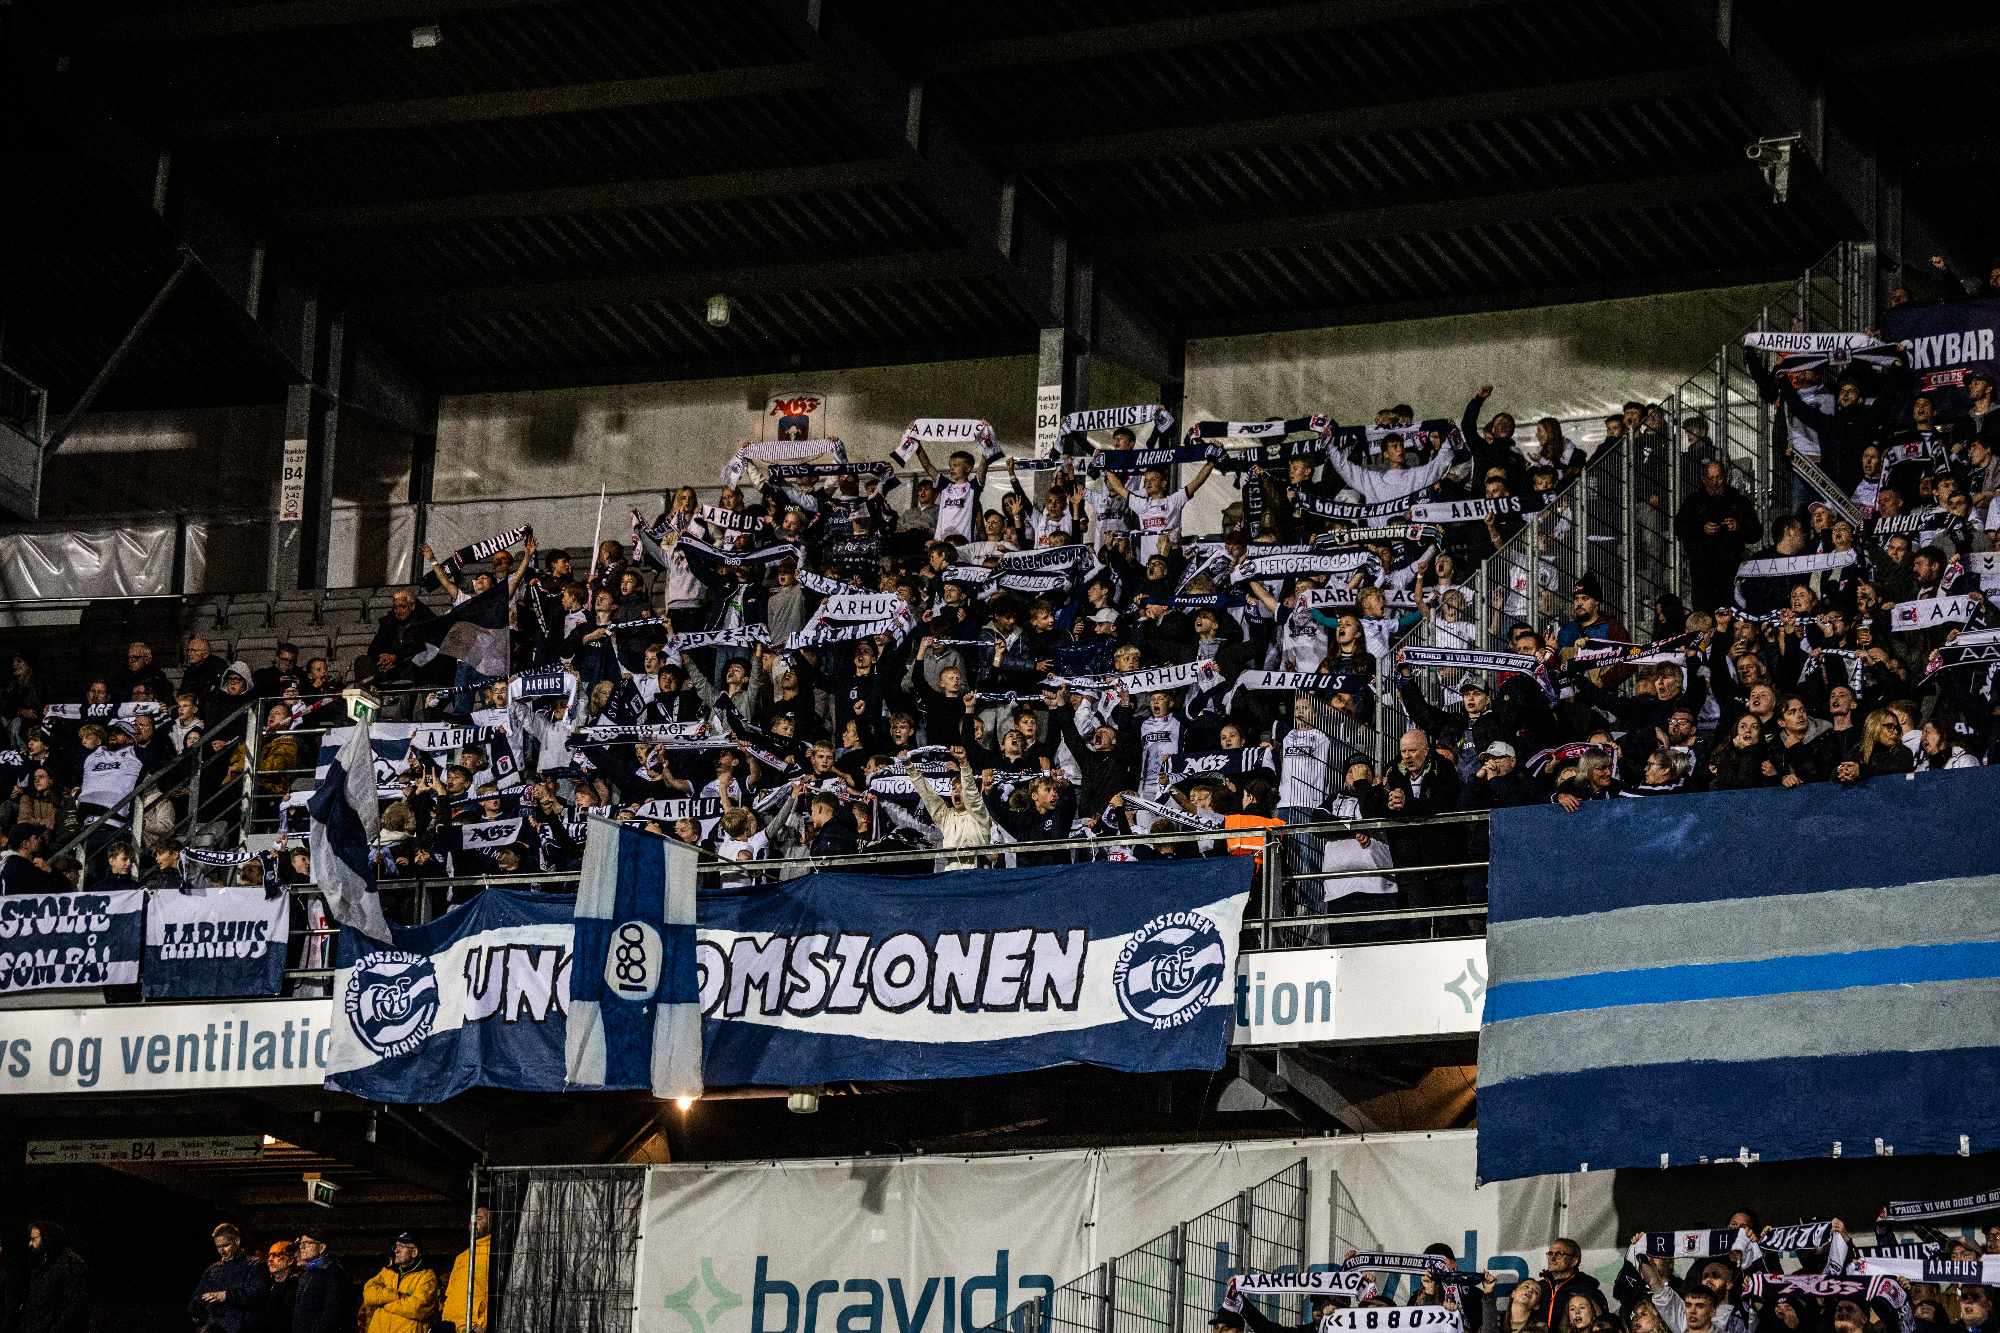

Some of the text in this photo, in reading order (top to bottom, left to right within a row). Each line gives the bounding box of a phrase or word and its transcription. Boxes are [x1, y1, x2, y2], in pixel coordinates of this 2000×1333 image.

[1758, 335, 1811, 350] AARHUS
[1900, 328, 1995, 370] SKYBAR
[1038, 414, 1058, 428] B4
[1076, 406, 1137, 430] AARHUS
[911, 422, 985, 438] AARHUS
[1136, 449, 1176, 466] AARHUS
[284, 467, 303, 480] B4
[1451, 497, 1521, 518] AARHUS
[700, 507, 764, 531] ARHUS
[472, 527, 523, 560] AARHUS
[1751, 551, 1855, 574] AARHUS
[525, 677, 561, 691] AARHUS
[1262, 672, 1347, 689] AARHUS
[658, 723, 688, 735] AGF
[649, 798, 723, 817] AARHU
[0, 894, 111, 938] STOLTE
[161, 920, 268, 960] AARHUS
[1113, 912, 1214, 984] UNGDOMSZONEN
[618, 922, 647, 992] 1880
[0, 949, 59, 990] SOM
[1153, 995, 1210, 1030] AARHUS
[384, 1021, 433, 1059] AARHUS
[50, 1036, 102, 1087] og
[131, 1142, 156, 1160] B4
[1929, 1259, 1977, 1276] AARHUS
[1242, 1272, 1322, 1288] AARHUS
[751, 1250, 1055, 1333] bravida
[1348, 1310, 1424, 1329] 1880
